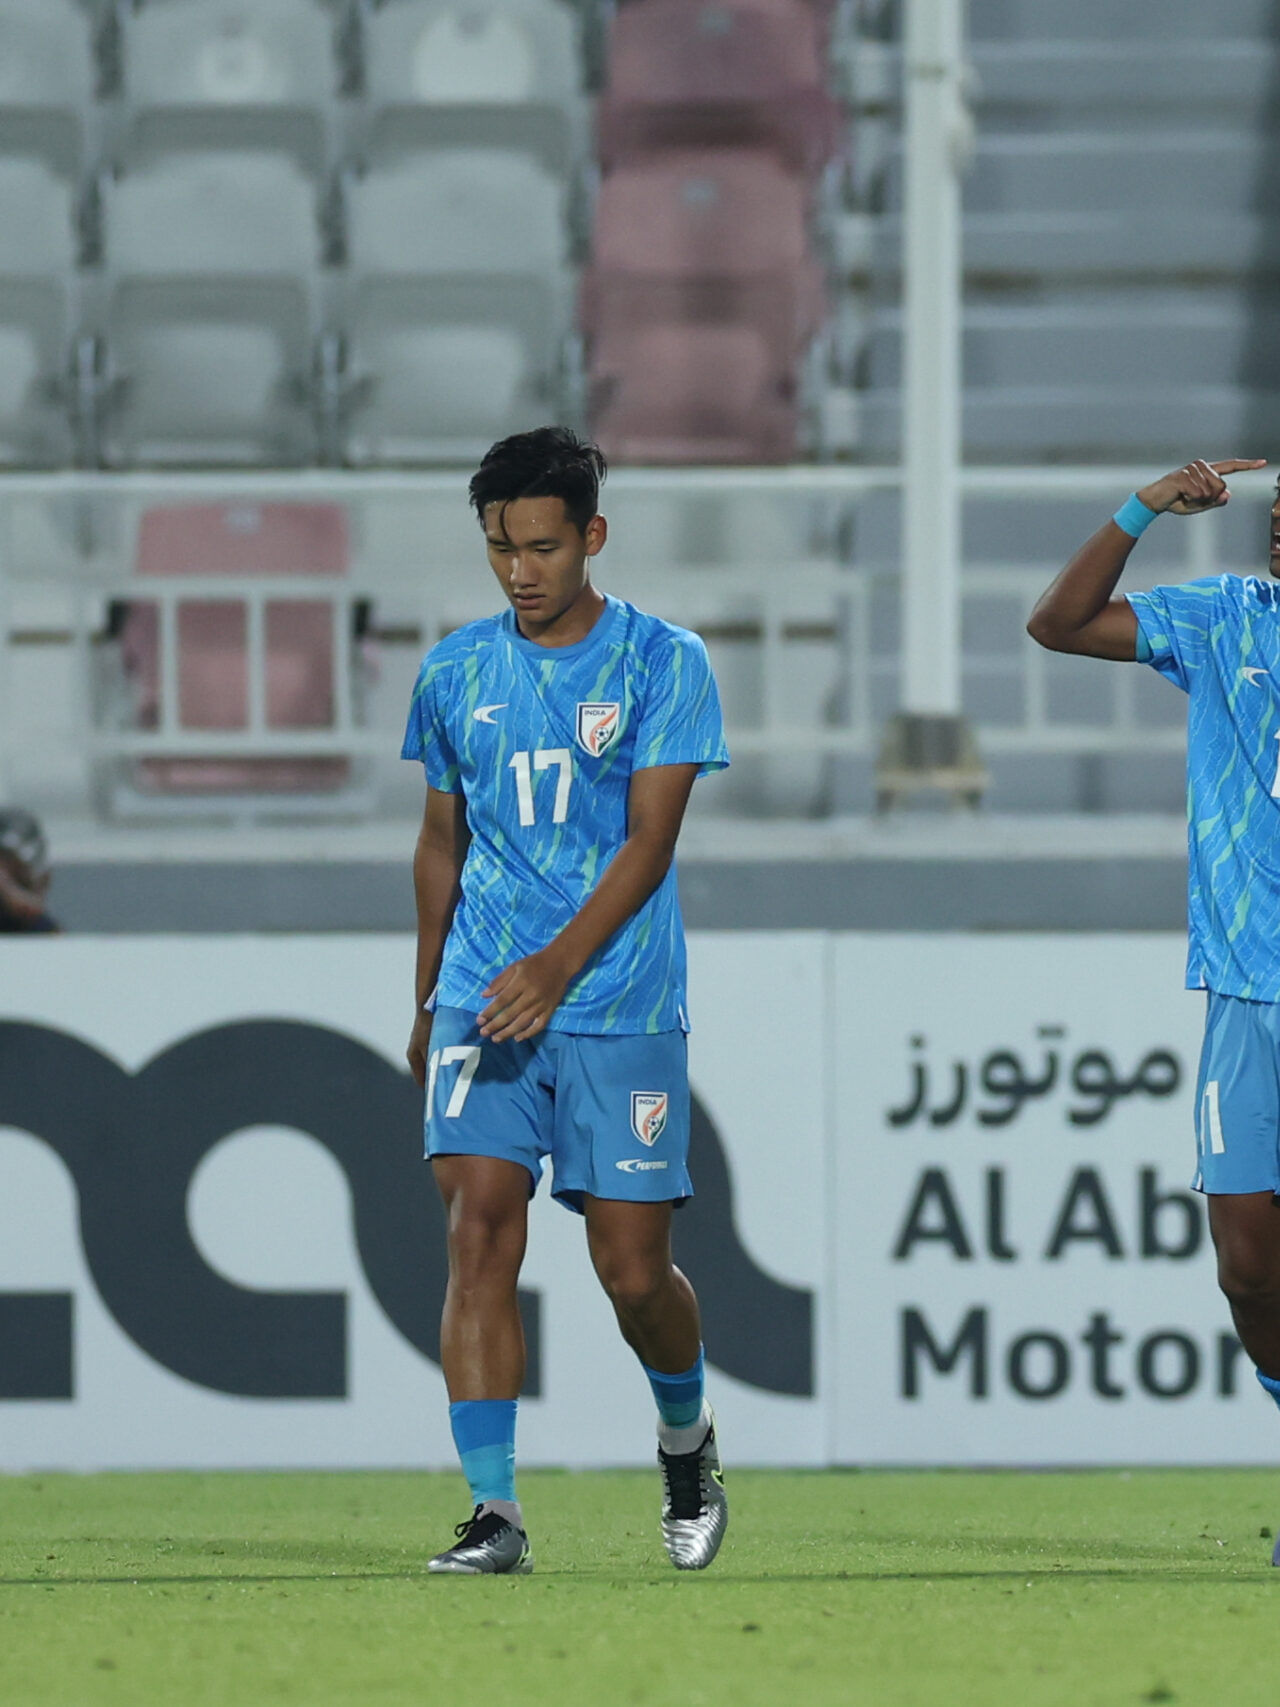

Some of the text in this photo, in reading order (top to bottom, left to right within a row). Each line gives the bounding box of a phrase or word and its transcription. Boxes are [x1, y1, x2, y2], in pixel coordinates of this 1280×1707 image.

[584, 709, 607, 717] INDIA
[508, 748, 572, 826] 17
[425, 1043, 482, 1121] 17
[886, 1026, 1183, 1129] موتورز
[892, 1166, 1019, 1263] Al
[901, 1305, 1245, 1402] Motor
